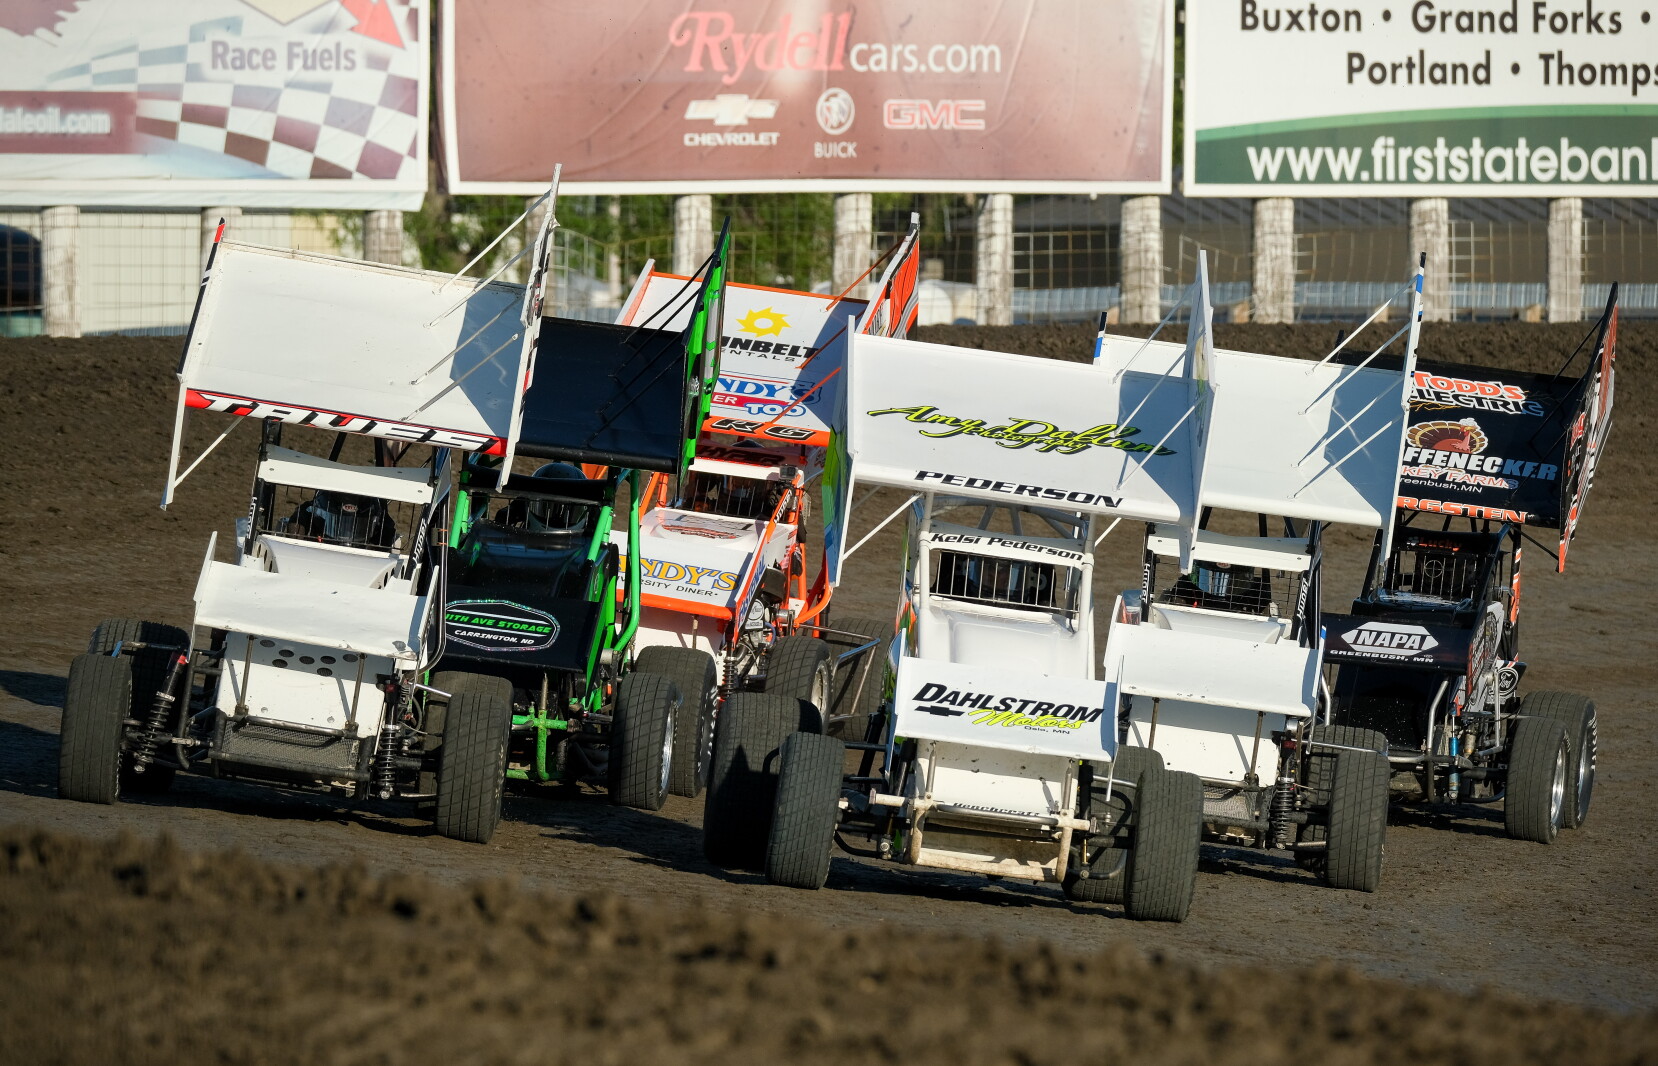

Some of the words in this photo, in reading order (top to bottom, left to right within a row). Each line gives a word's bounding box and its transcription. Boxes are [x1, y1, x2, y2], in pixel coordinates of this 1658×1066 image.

[1240, 1, 1363, 32] Buxton
[1411, 0, 1518, 34] Grand
[1532, 1, 1623, 34] Forks
[210, 39, 277, 71] Race
[287, 40, 357, 72] Fuels
[1347, 50, 1491, 85] Portland
[883, 99, 986, 131] GMC
[684, 131, 780, 147] CHEVROLET
[813, 142, 858, 159] BUICK
[745, 402, 807, 417] TOO
[914, 469, 1124, 509] PEDERSON
[930, 532, 982, 546] Kelsi
[987, 536, 1084, 562] Pederson
[471, 617, 496, 626] AVE
[497, 620, 552, 634] STORAGE
[1356, 630, 1422, 651] NAPA
[912, 682, 1105, 723] DAHLSTROM
[968, 708, 1088, 730] Motors
